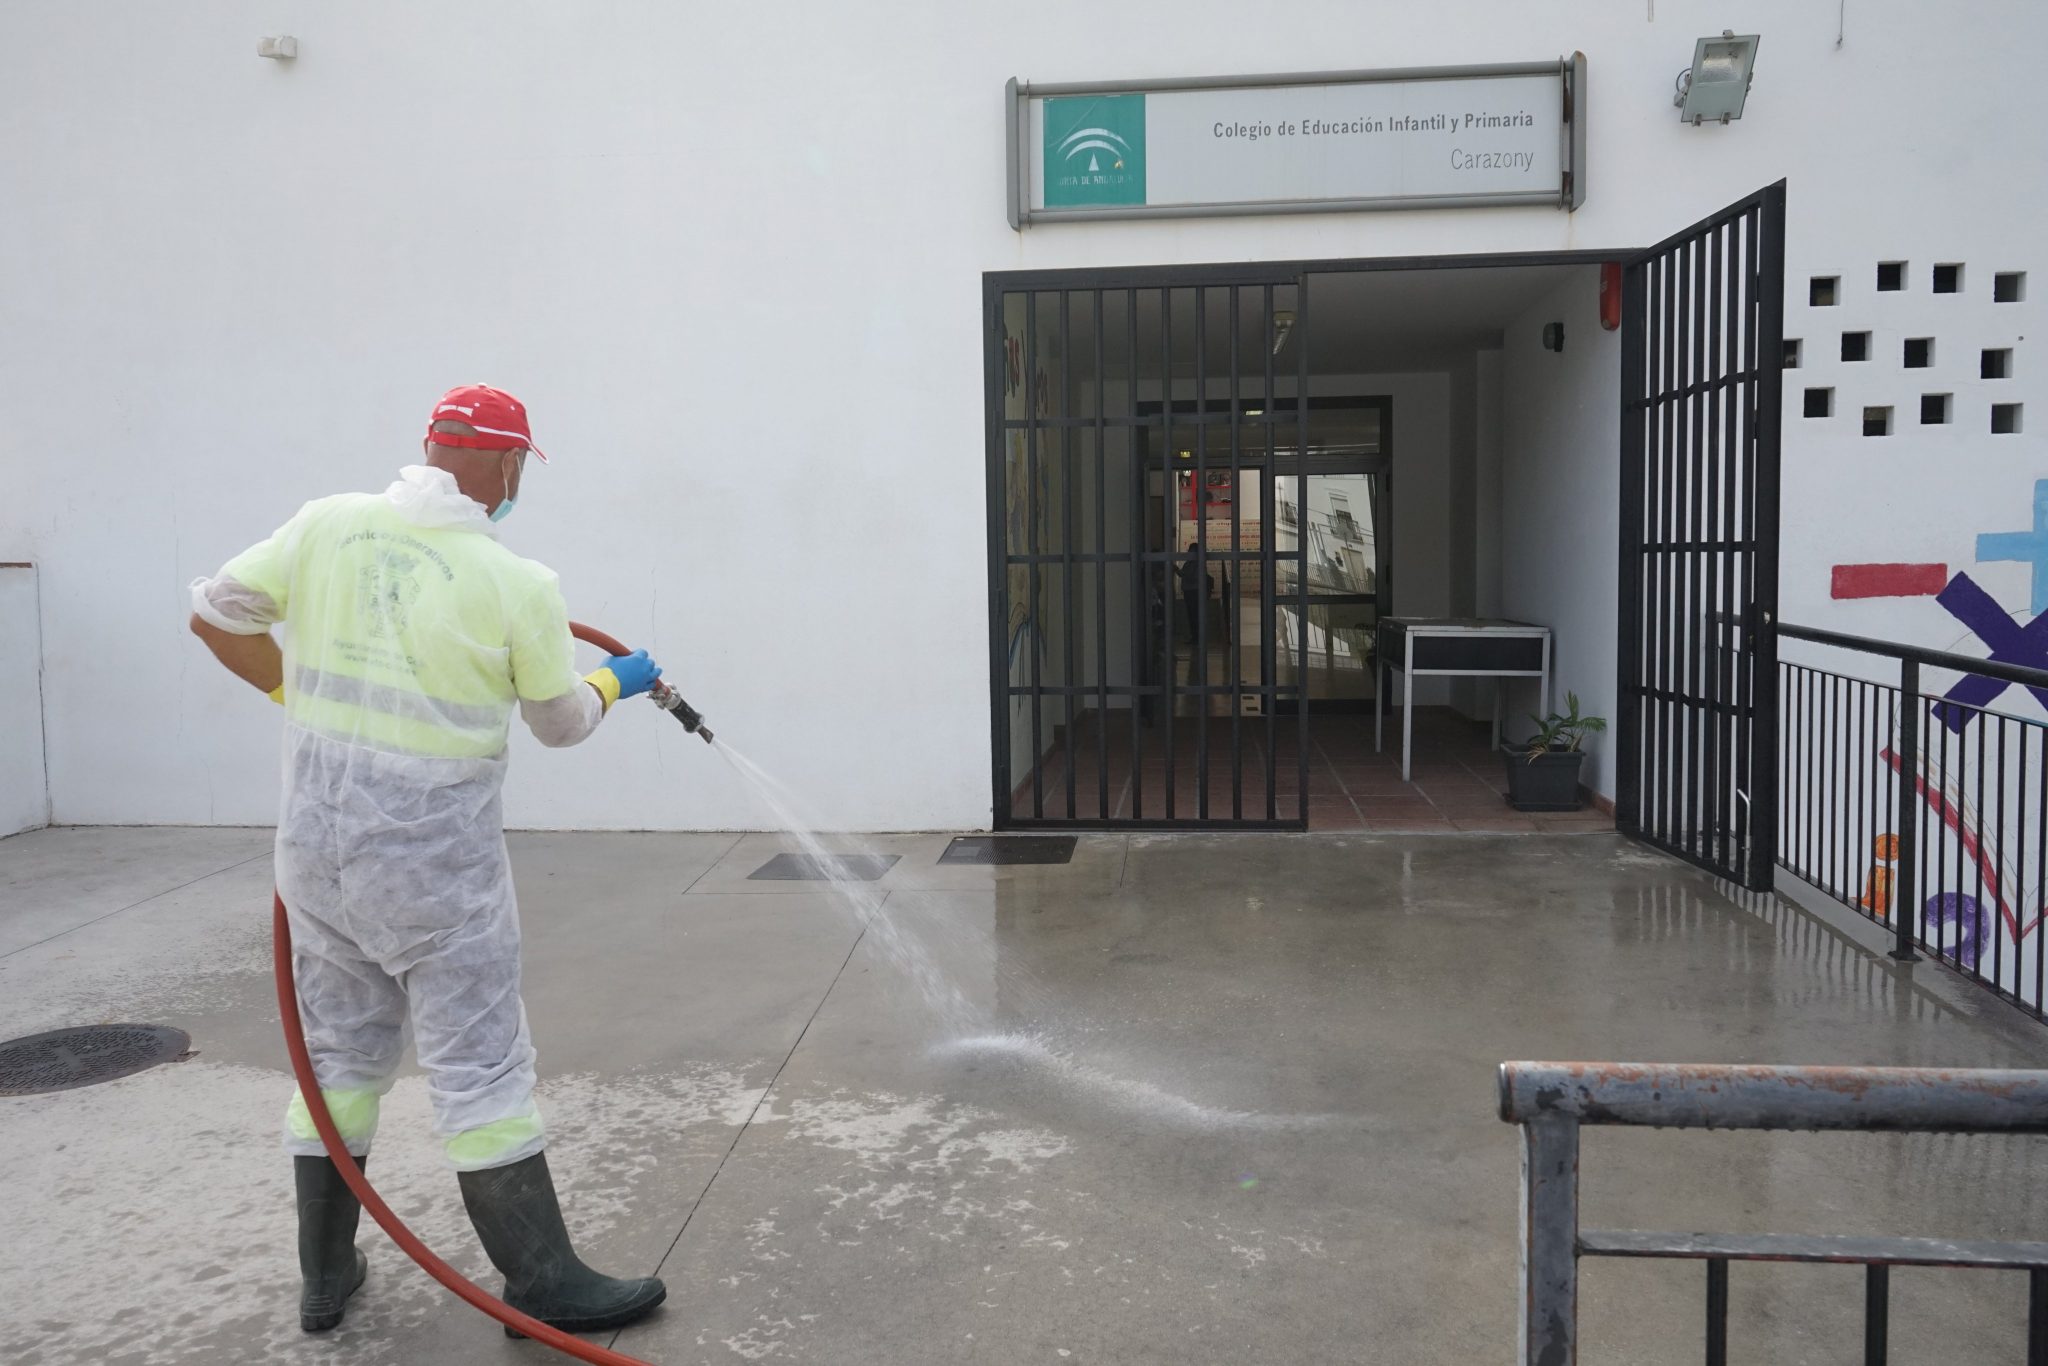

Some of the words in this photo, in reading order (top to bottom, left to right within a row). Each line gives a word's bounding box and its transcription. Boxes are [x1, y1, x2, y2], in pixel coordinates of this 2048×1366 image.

[1213, 120, 1272, 141] Colegio
[1277, 120, 1296, 136] de
[1301, 116, 1383, 136] Educación
[1388, 113, 1446, 132] Infantil
[1450, 117, 1460, 134] y
[1464, 110, 1534, 129] Primaria
[1451, 148, 1534, 173] Carazony
[338, 529, 397, 549] ervicos
[400, 535, 455, 582] Operativos
